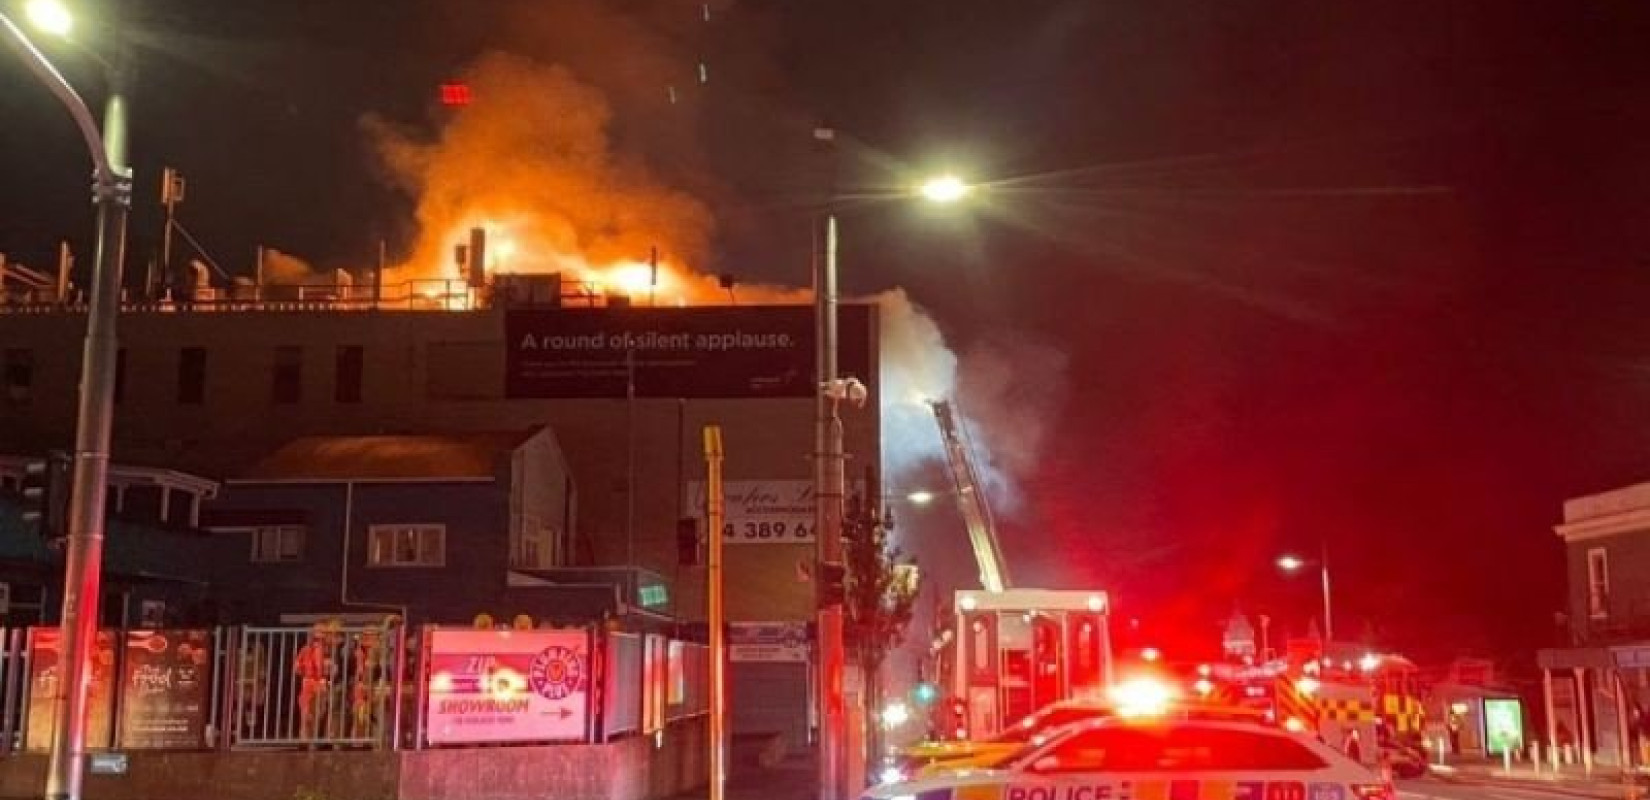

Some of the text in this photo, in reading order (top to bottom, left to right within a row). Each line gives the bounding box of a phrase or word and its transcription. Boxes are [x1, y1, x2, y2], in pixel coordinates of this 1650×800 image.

[521, 333, 537, 350] A
[544, 333, 604, 350] round
[635, 331, 690, 350] silent
[745, 521, 786, 538] 389
[1010, 785, 1112, 800] POLICE
